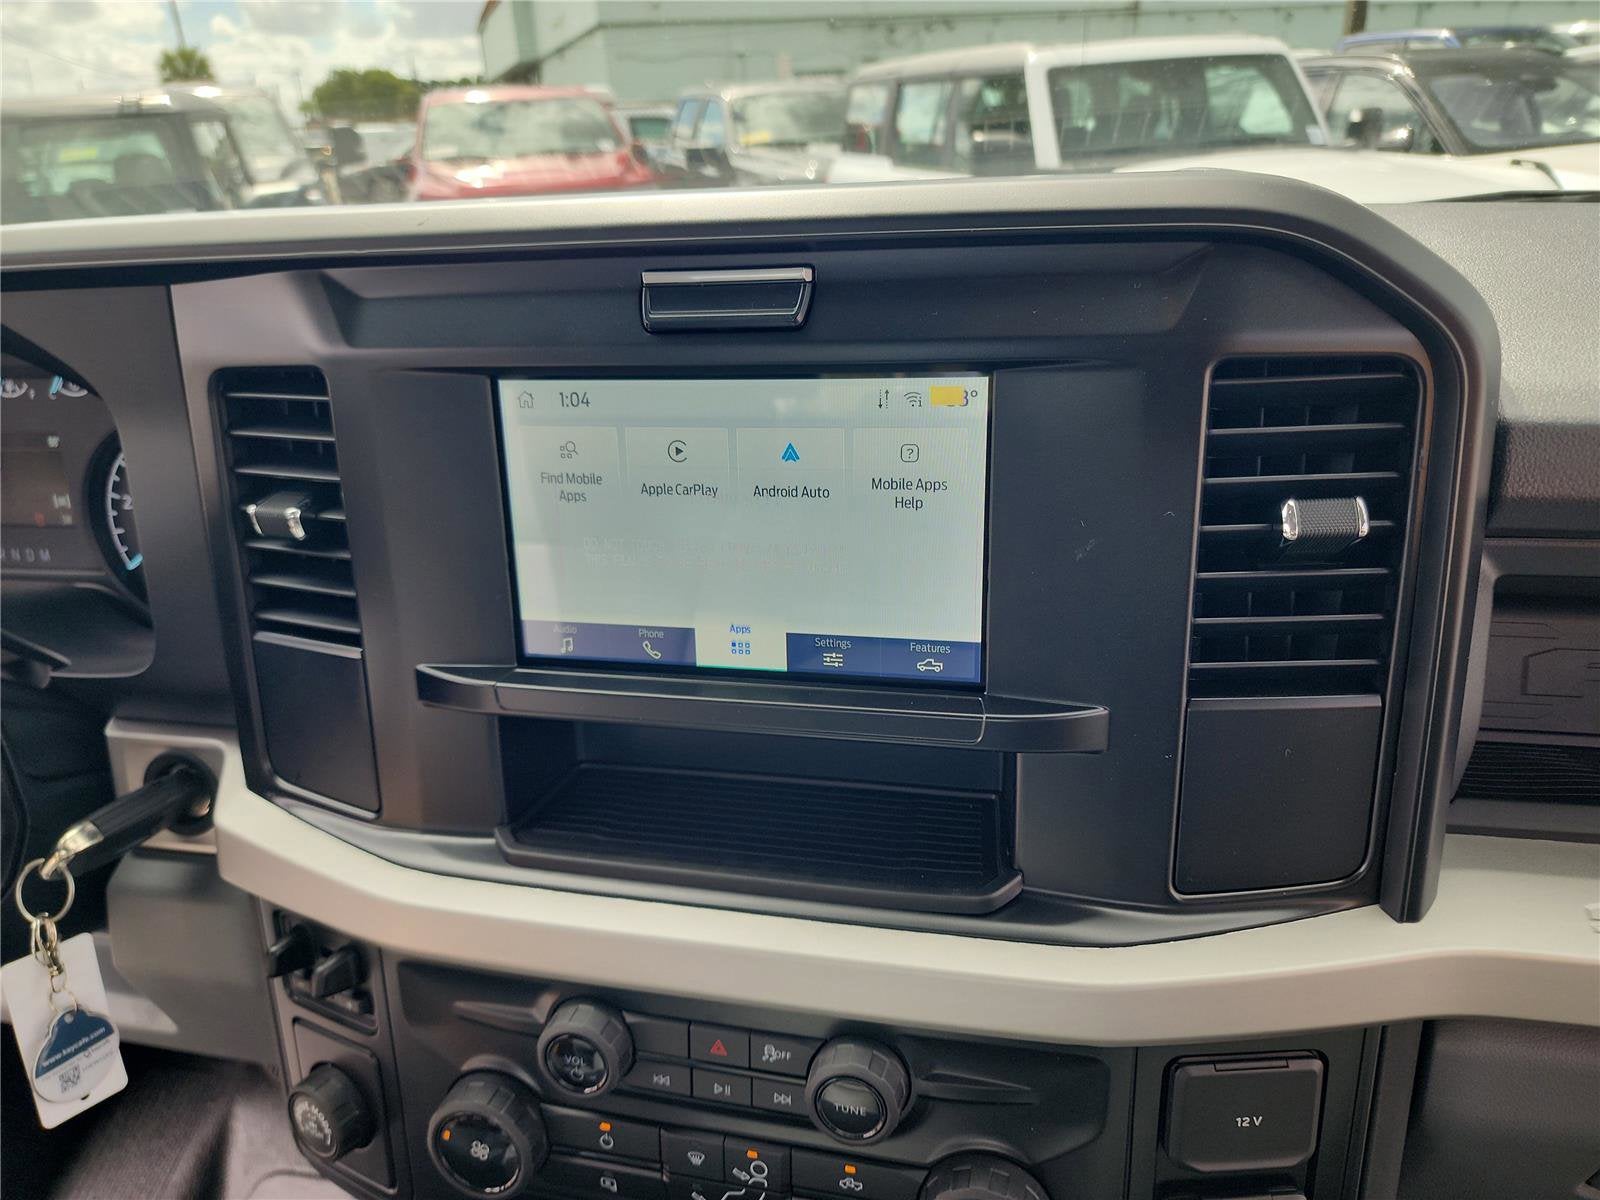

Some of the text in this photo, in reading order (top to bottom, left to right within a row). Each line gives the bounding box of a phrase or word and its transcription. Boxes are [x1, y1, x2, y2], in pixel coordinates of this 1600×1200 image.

[559, 391, 591, 408] 1:04
[540, 472, 603, 486] Find Mobile
[871, 477, 948, 493] Mobile Apps
[559, 490, 587, 504] Apps
[641, 482, 719, 499] Apple CarPlay
[753, 485, 830, 499] Android Auto
[895, 496, 924, 511] Help
[638, 628, 664, 639] Phone
[729, 623, 751, 634] Apps
[814, 637, 852, 650] Settings
[910, 642, 951, 654] Features
[564, 1054, 586, 1065] VOL
[774, 1050, 792, 1061] OFF
[834, 1102, 867, 1117] TUNE
[1235, 1115, 1263, 1127] 12 V
